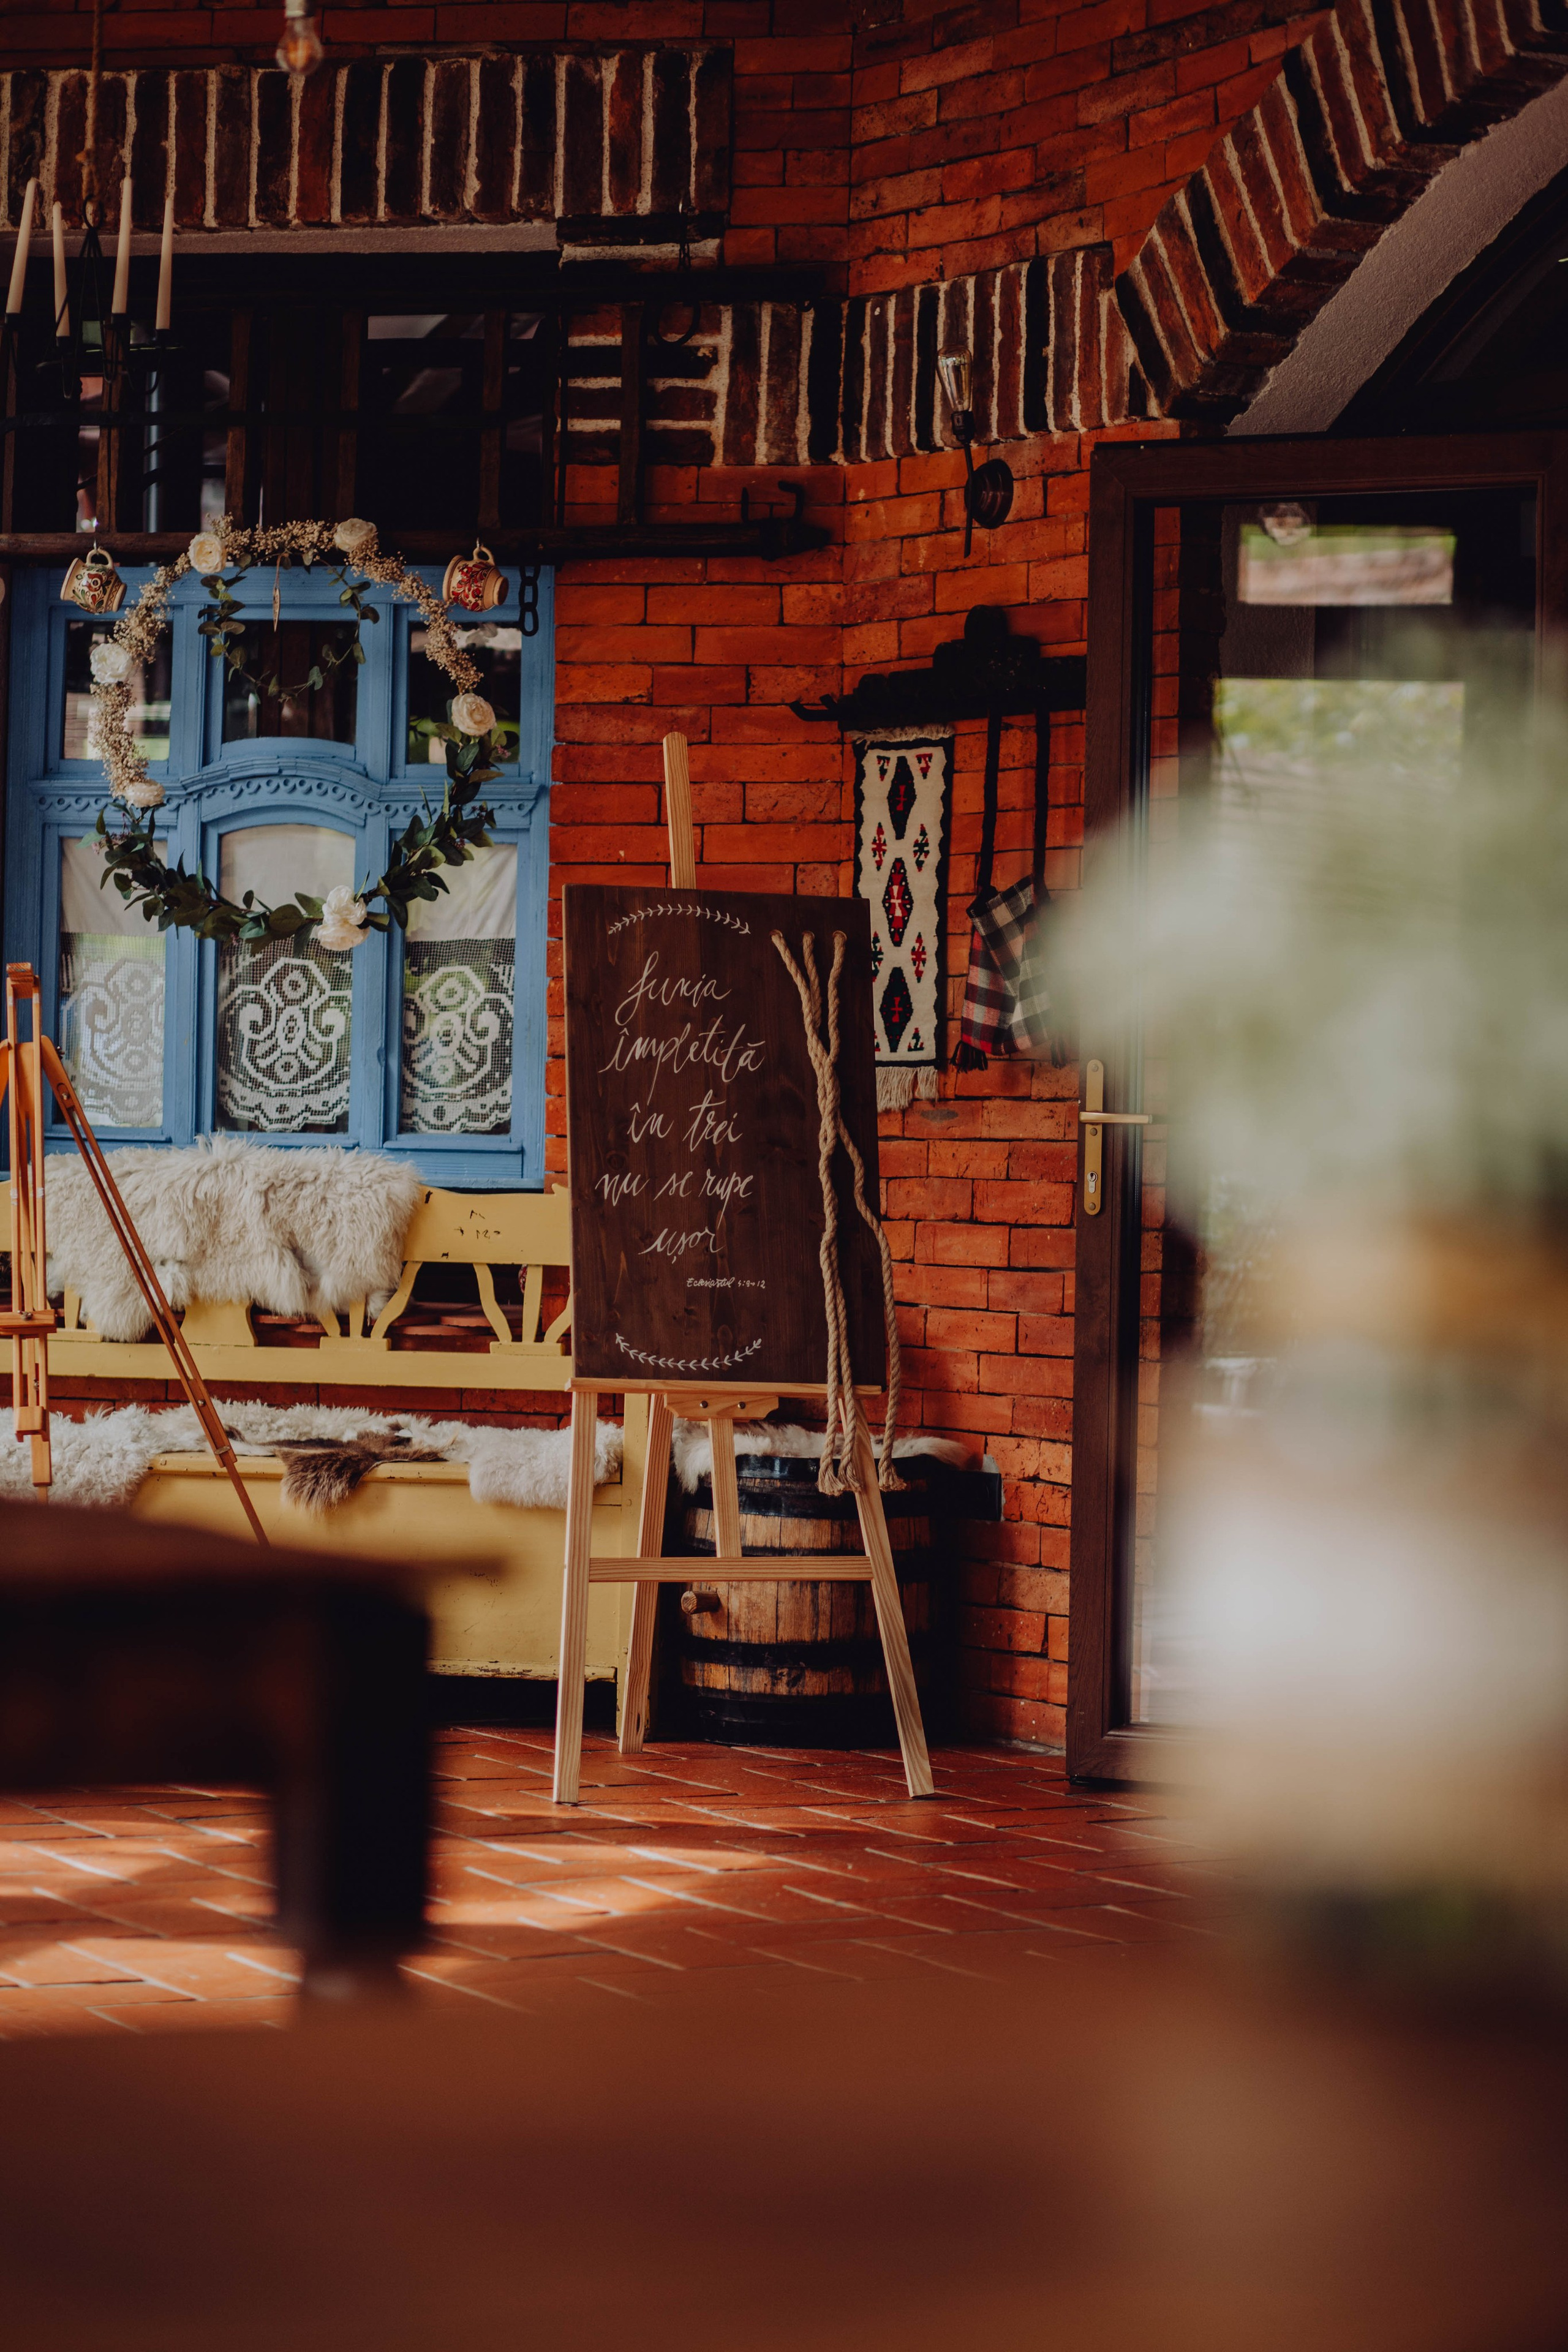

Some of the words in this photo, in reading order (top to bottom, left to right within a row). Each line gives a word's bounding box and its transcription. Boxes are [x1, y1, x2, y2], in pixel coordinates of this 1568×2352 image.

[615, 951, 732, 1026] funia
[627, 1102, 674, 1144] în
[682, 1089, 743, 1152] trei
[595, 1172, 650, 1207] nu
[653, 1170, 693, 1201] se
[698, 1168, 754, 1230] rupe
[638, 1226, 725, 1264] ușor
